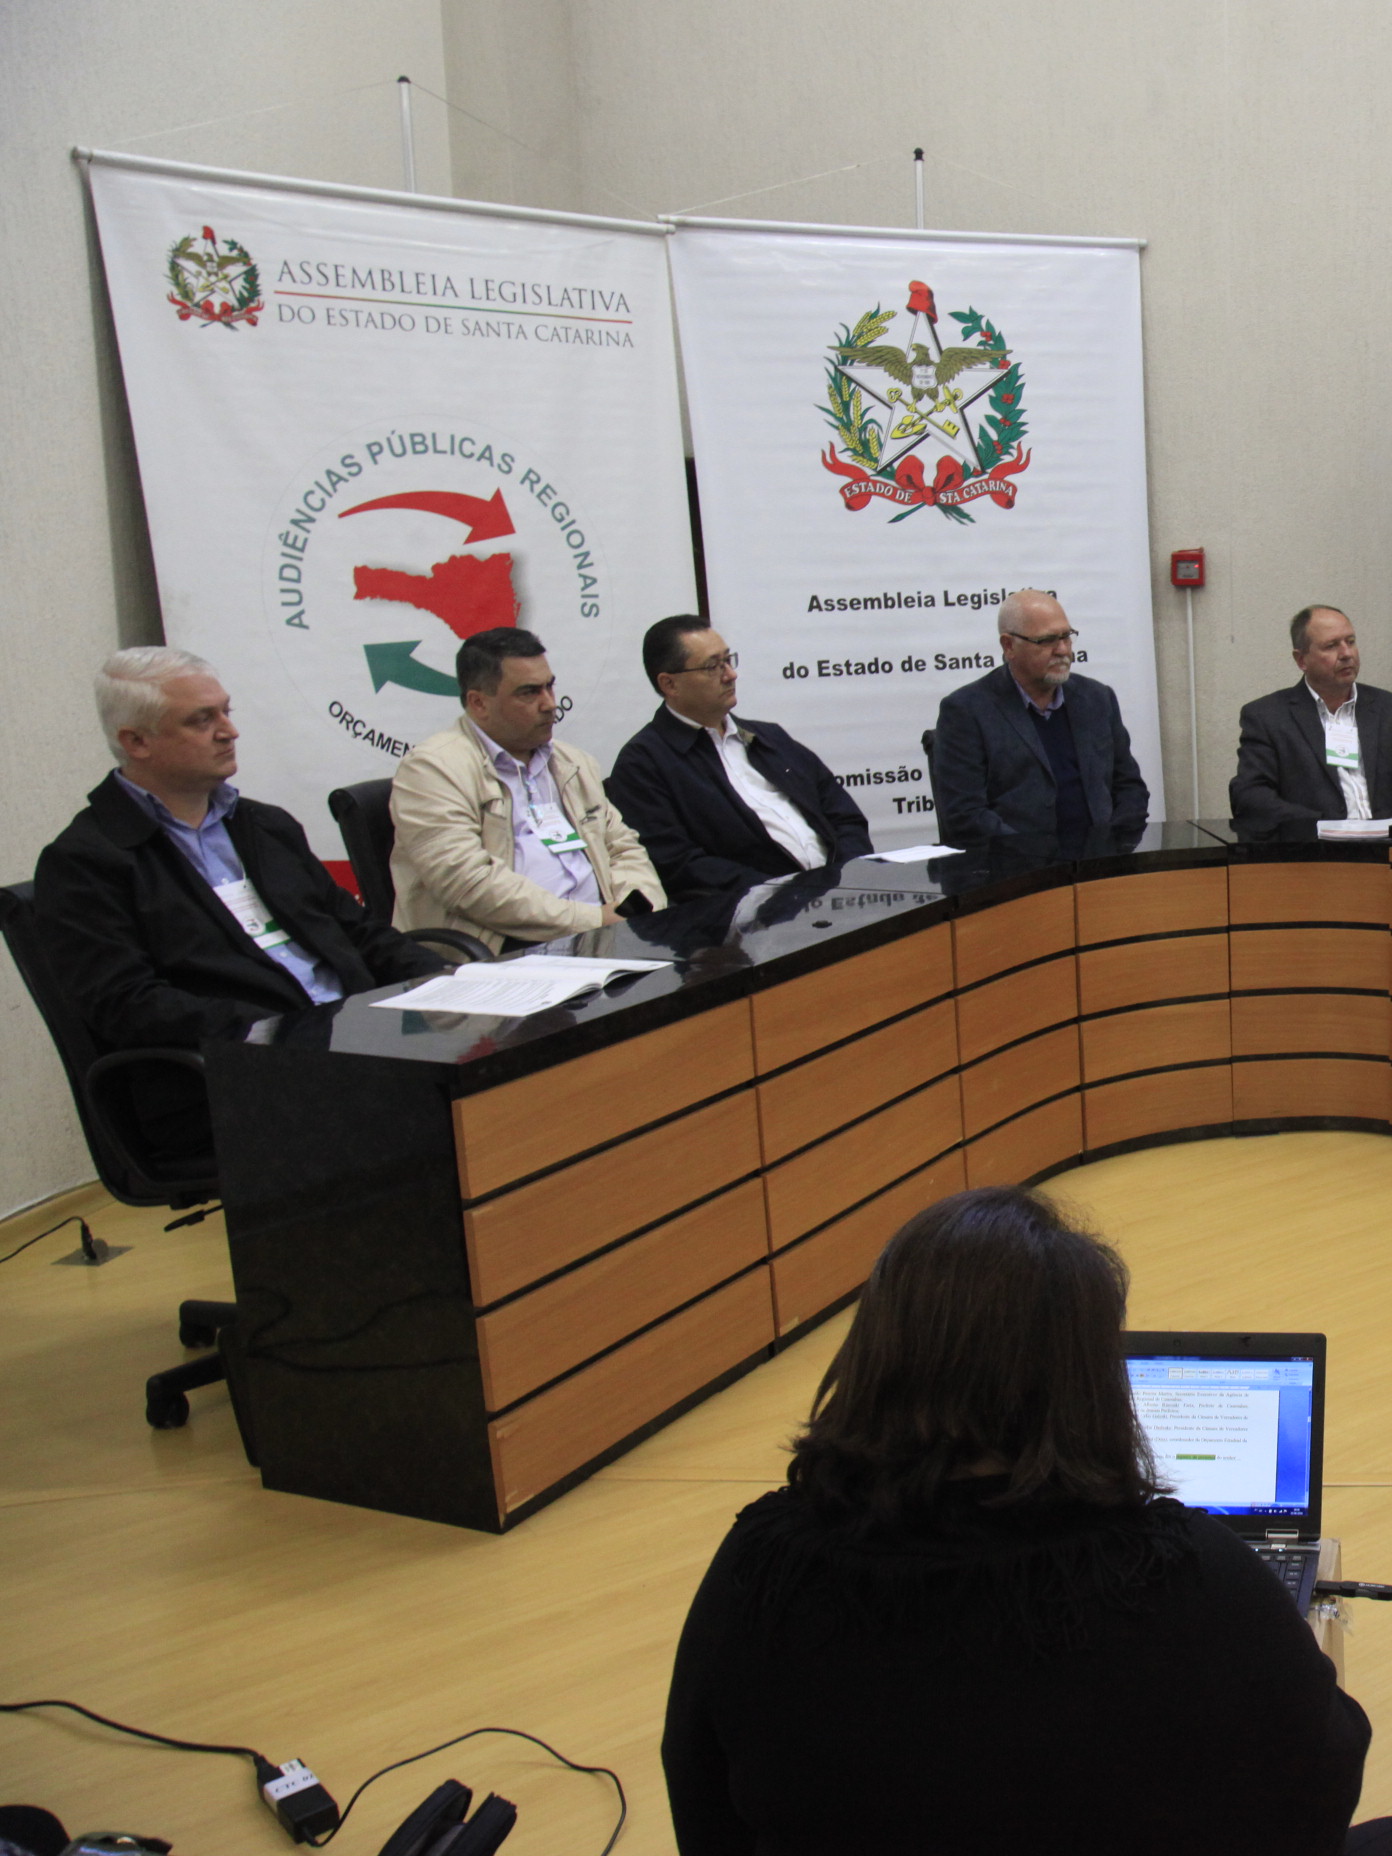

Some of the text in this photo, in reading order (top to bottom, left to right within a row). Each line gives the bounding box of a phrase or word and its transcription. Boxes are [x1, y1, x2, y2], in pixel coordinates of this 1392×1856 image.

[277, 259, 631, 313] ASSEMBLEIA LEGISLATIVA
[277, 303, 316, 325] DO
[326, 307, 416, 332] ESTADO
[424, 315, 454, 335] DE
[461, 317, 528, 341] SANTA
[534, 324, 634, 348] CATARINA
[843, 481, 893, 499] ESTADO
[896, 488, 913, 503] DE
[963, 479, 1014, 499] CATARINA
[278, 429, 600, 630] AUDIÊNCIAS PÚBLICAS REGIONAIS
[807, 590, 936, 613] Assembleia
[782, 661, 809, 679] do
[817, 657, 893, 678] Estado
[900, 655, 927, 673] de
[934, 651, 995, 671] Santa
[328, 700, 416, 758] ORÇAMEN
[833, 765, 923, 787] omissão
[892, 795, 935, 815] Trib
